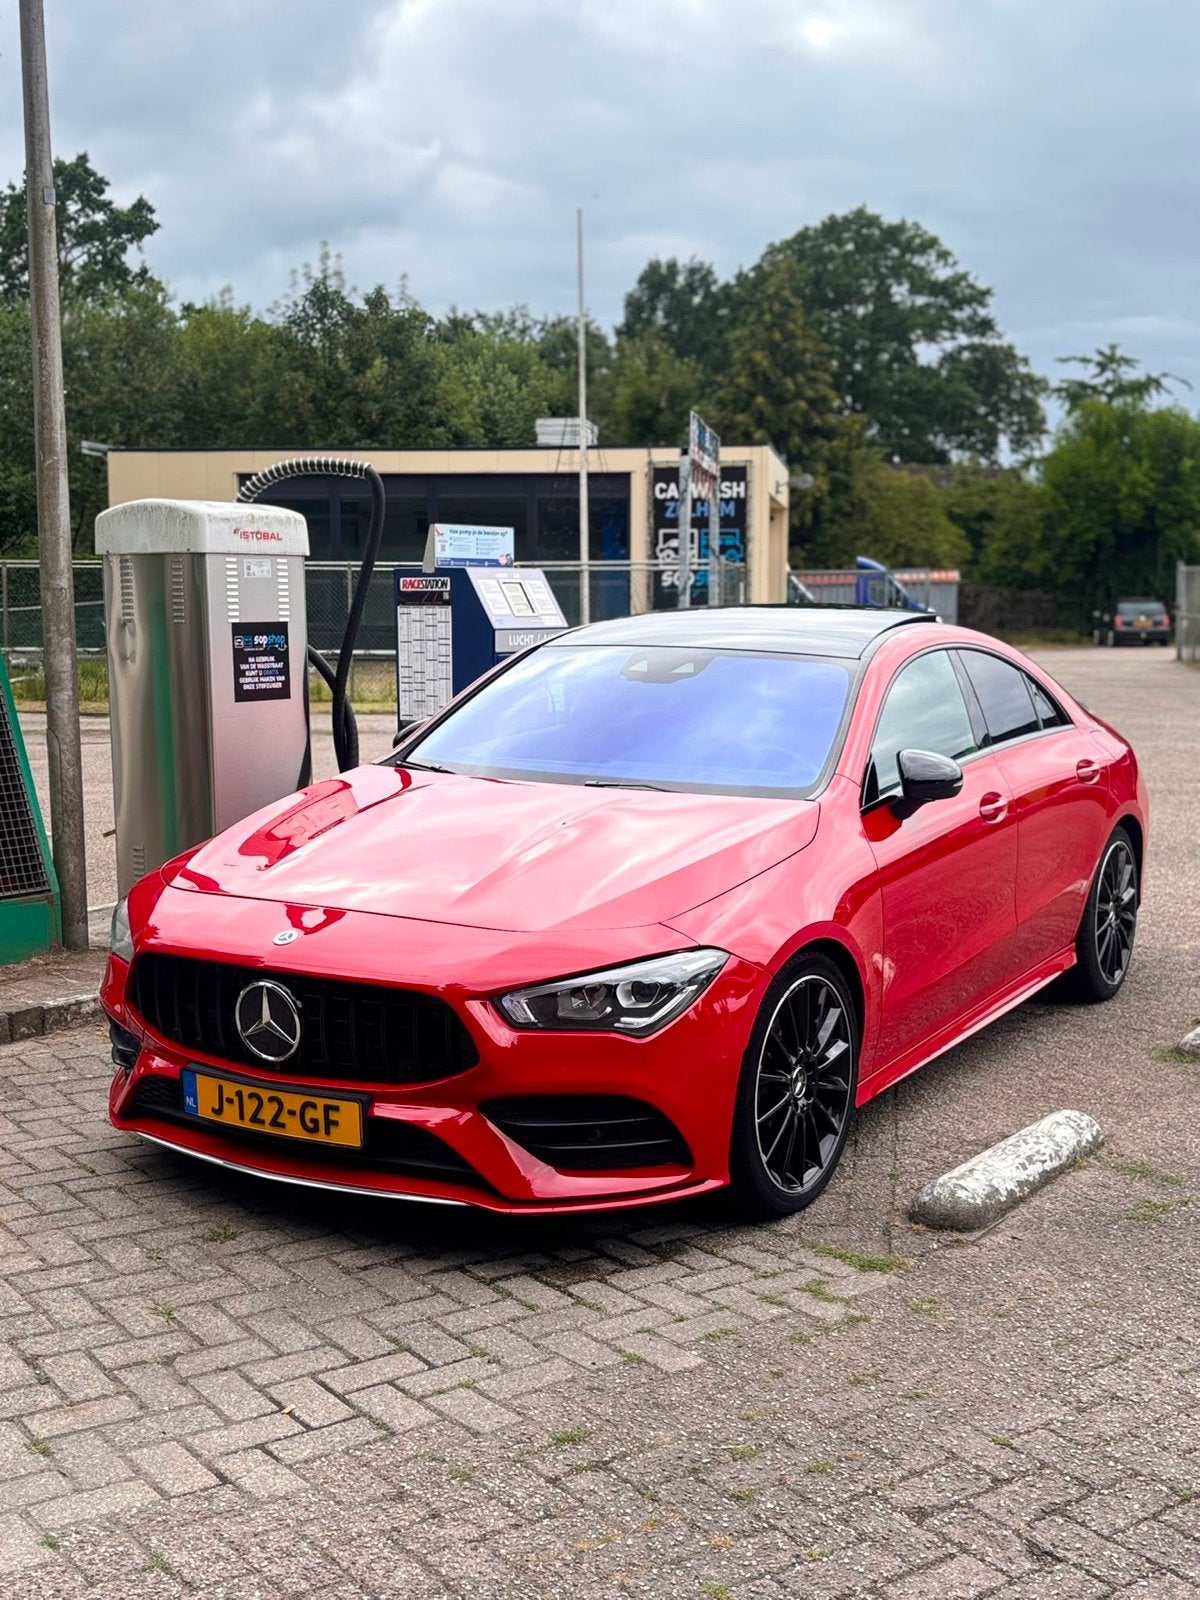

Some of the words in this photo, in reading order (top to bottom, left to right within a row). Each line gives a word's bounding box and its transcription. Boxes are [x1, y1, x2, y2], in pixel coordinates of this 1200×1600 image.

[240, 530, 282, 541] ISTOBAL
[402, 579, 448, 589] RACESTATION
[508, 634, 534, 646] LUCHT
[186, 1096, 196, 1108] NL
[211, 1084, 340, 1135] J-122-GF
